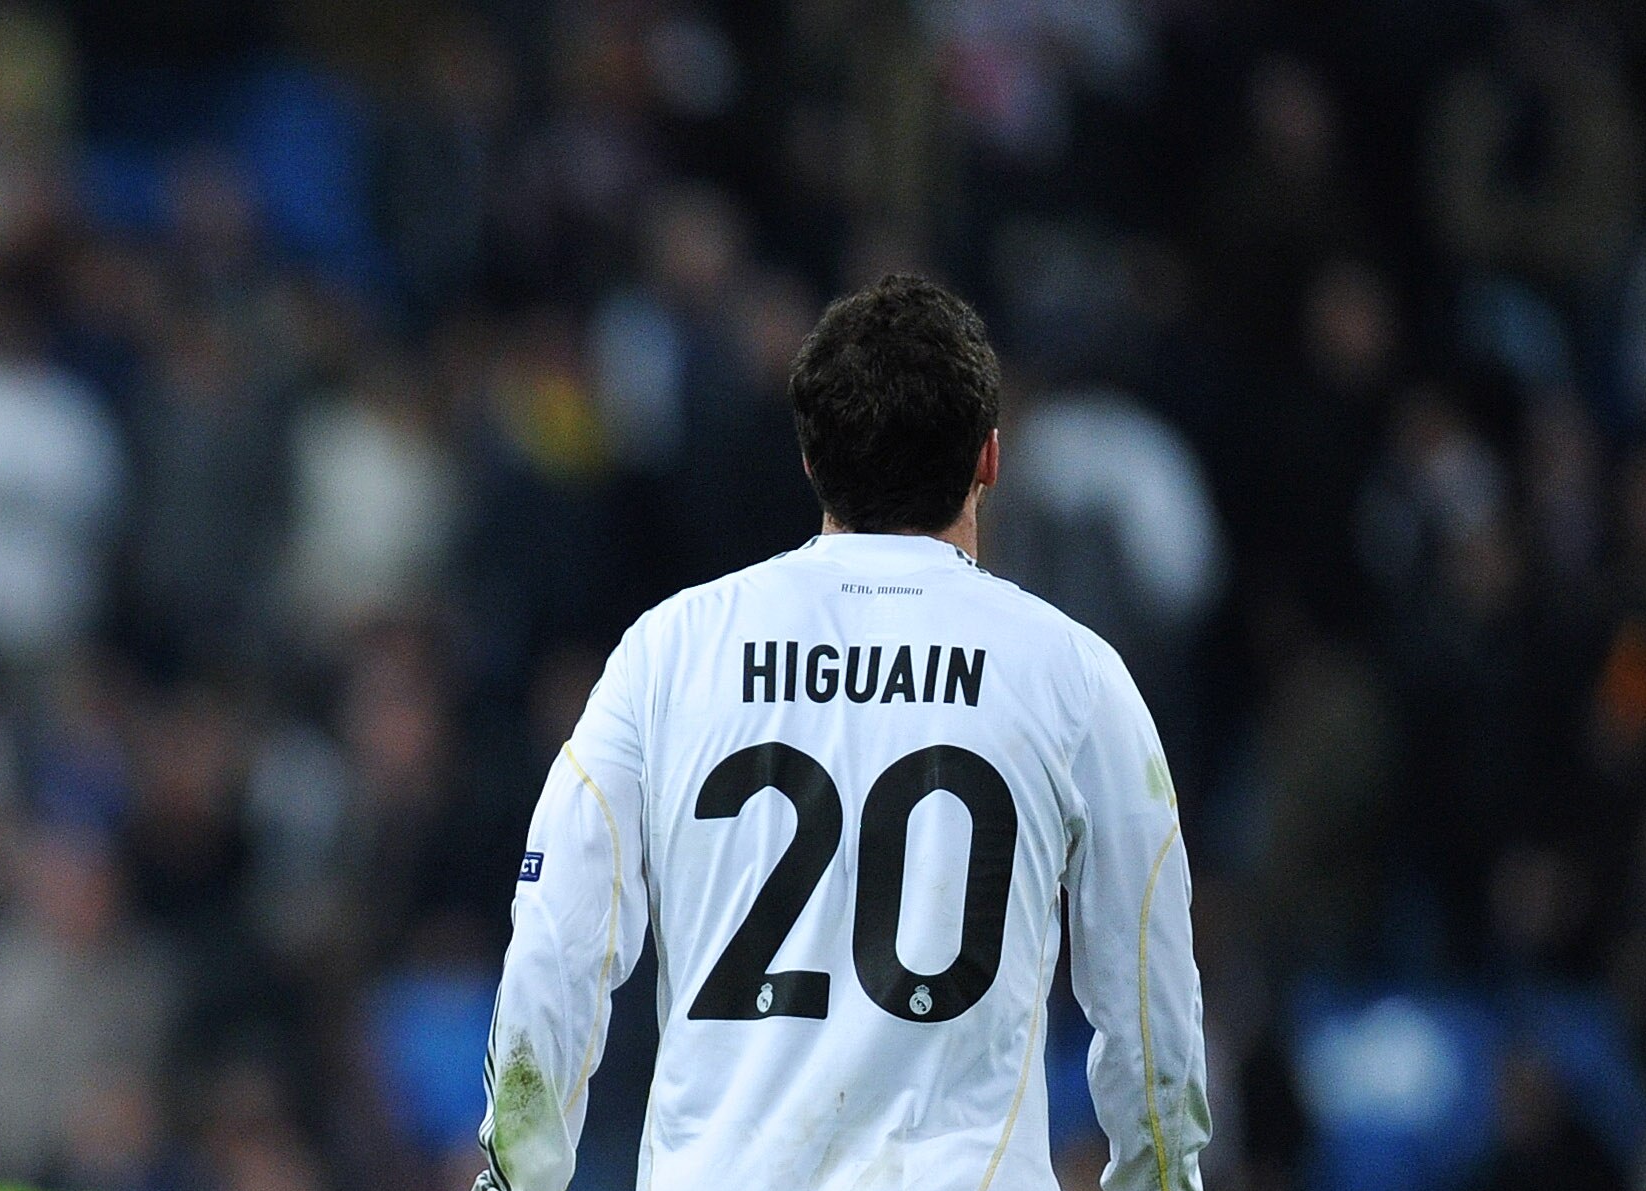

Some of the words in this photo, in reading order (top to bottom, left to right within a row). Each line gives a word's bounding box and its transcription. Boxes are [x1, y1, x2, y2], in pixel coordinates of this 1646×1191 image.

[840, 583, 872, 594] REAL
[742, 641, 987, 707] HIGUAIN
[687, 741, 1019, 1023] 20
